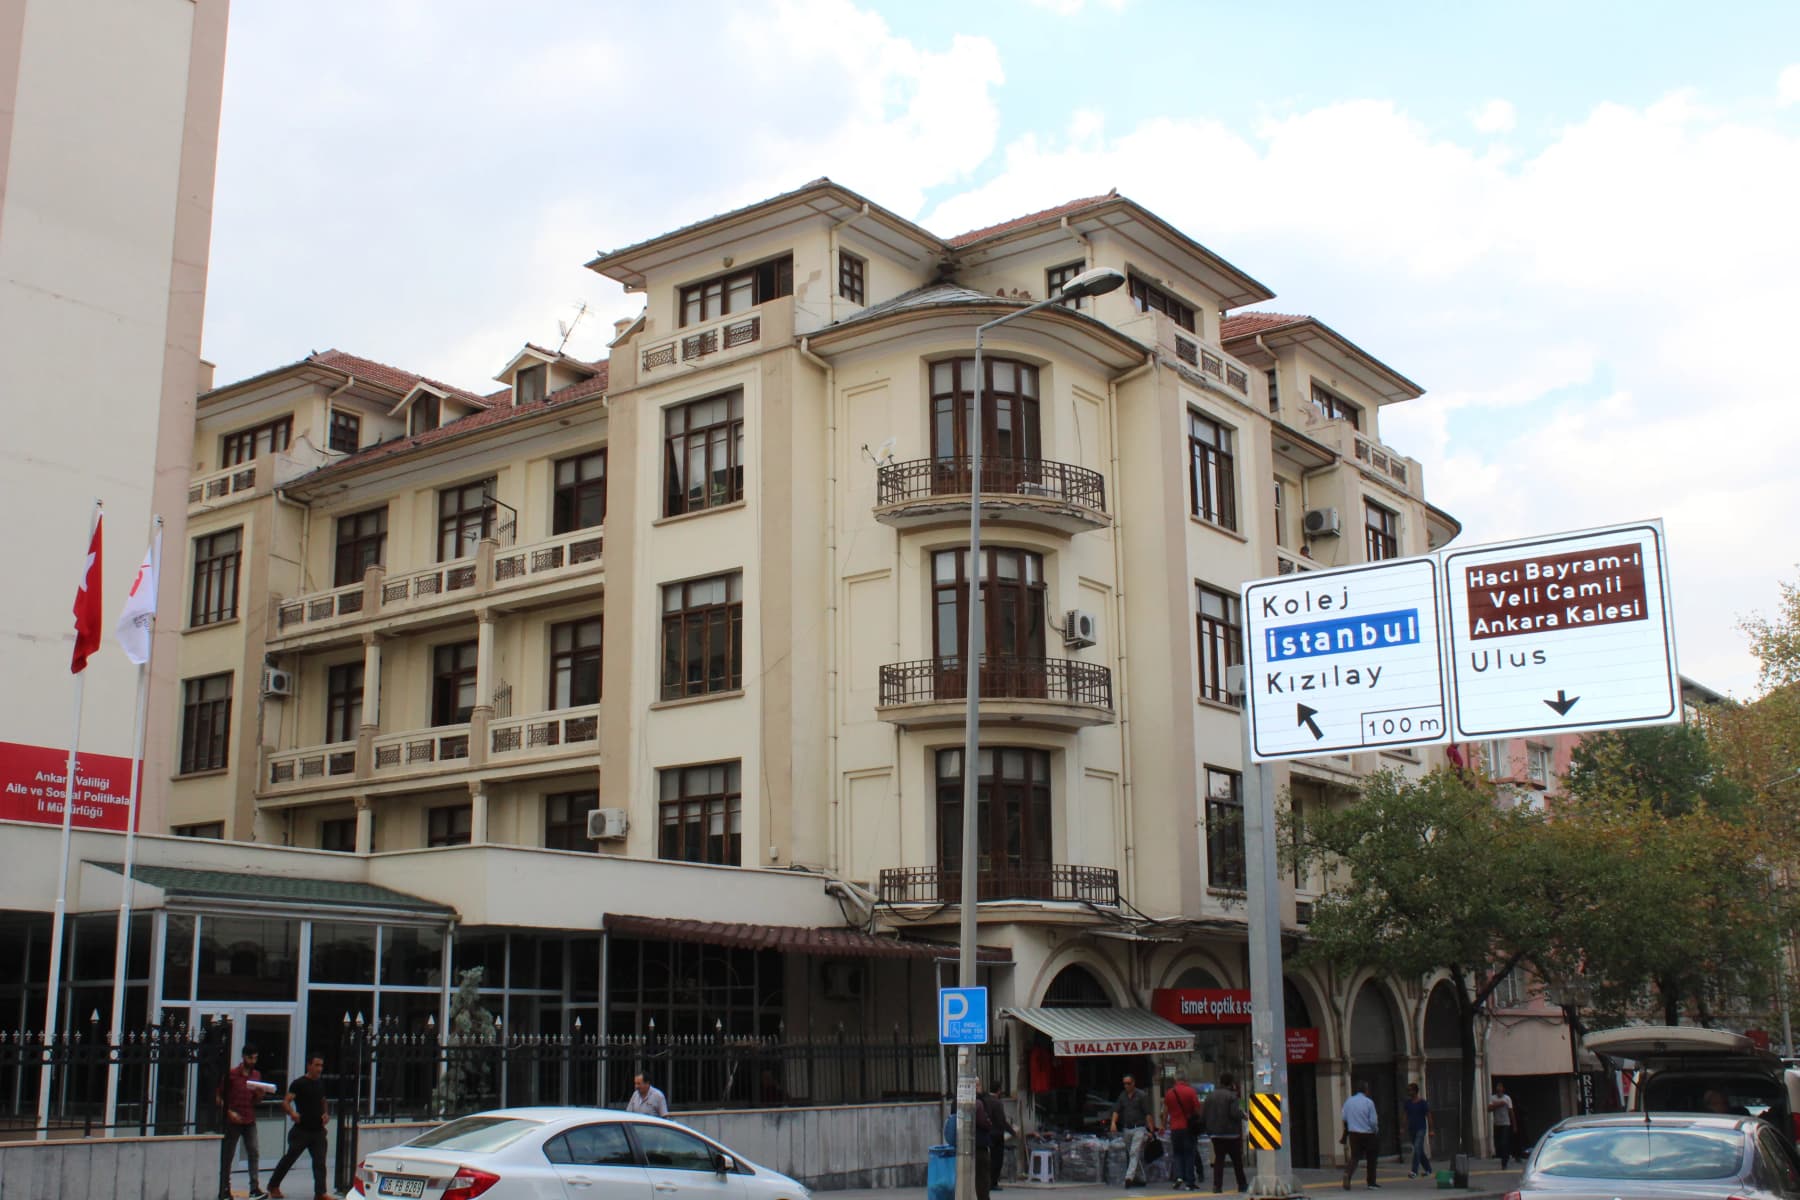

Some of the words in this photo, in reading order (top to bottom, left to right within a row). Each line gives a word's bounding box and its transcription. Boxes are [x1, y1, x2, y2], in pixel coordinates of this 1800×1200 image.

[1469, 569, 1518, 588] Hacı
[1525, 552, 1639, 580] Bayram-ı
[1262, 585, 1350, 618] Kolej
[1490, 587, 1539, 608] Veli
[1546, 576, 1622, 600] Camii
[1474, 613, 1559, 635] Ankara
[1566, 599, 1640, 624] Kalesi
[1268, 615, 1416, 657] İstanbul
[1471, 648, 1547, 673] Ulus
[1267, 664, 1382, 695] Kızılay
[1368, 716, 1411, 737] 100
[1419, 716, 1440, 732] m
[5, 783, 28, 795] Aile
[30, 786, 43, 796] ve
[46, 787, 81, 800] Sosal
[35, 770, 70, 785] Ankar
[75, 775, 110, 791] Valiliği
[47, 801, 104, 819] Müürlüğü
[1181, 995, 1208, 1014] ismet
[1210, 995, 1235, 1020] optik
[1073, 1041, 1138, 1054] MALATYA
[1141, 1039, 1187, 1052] PAZARI
